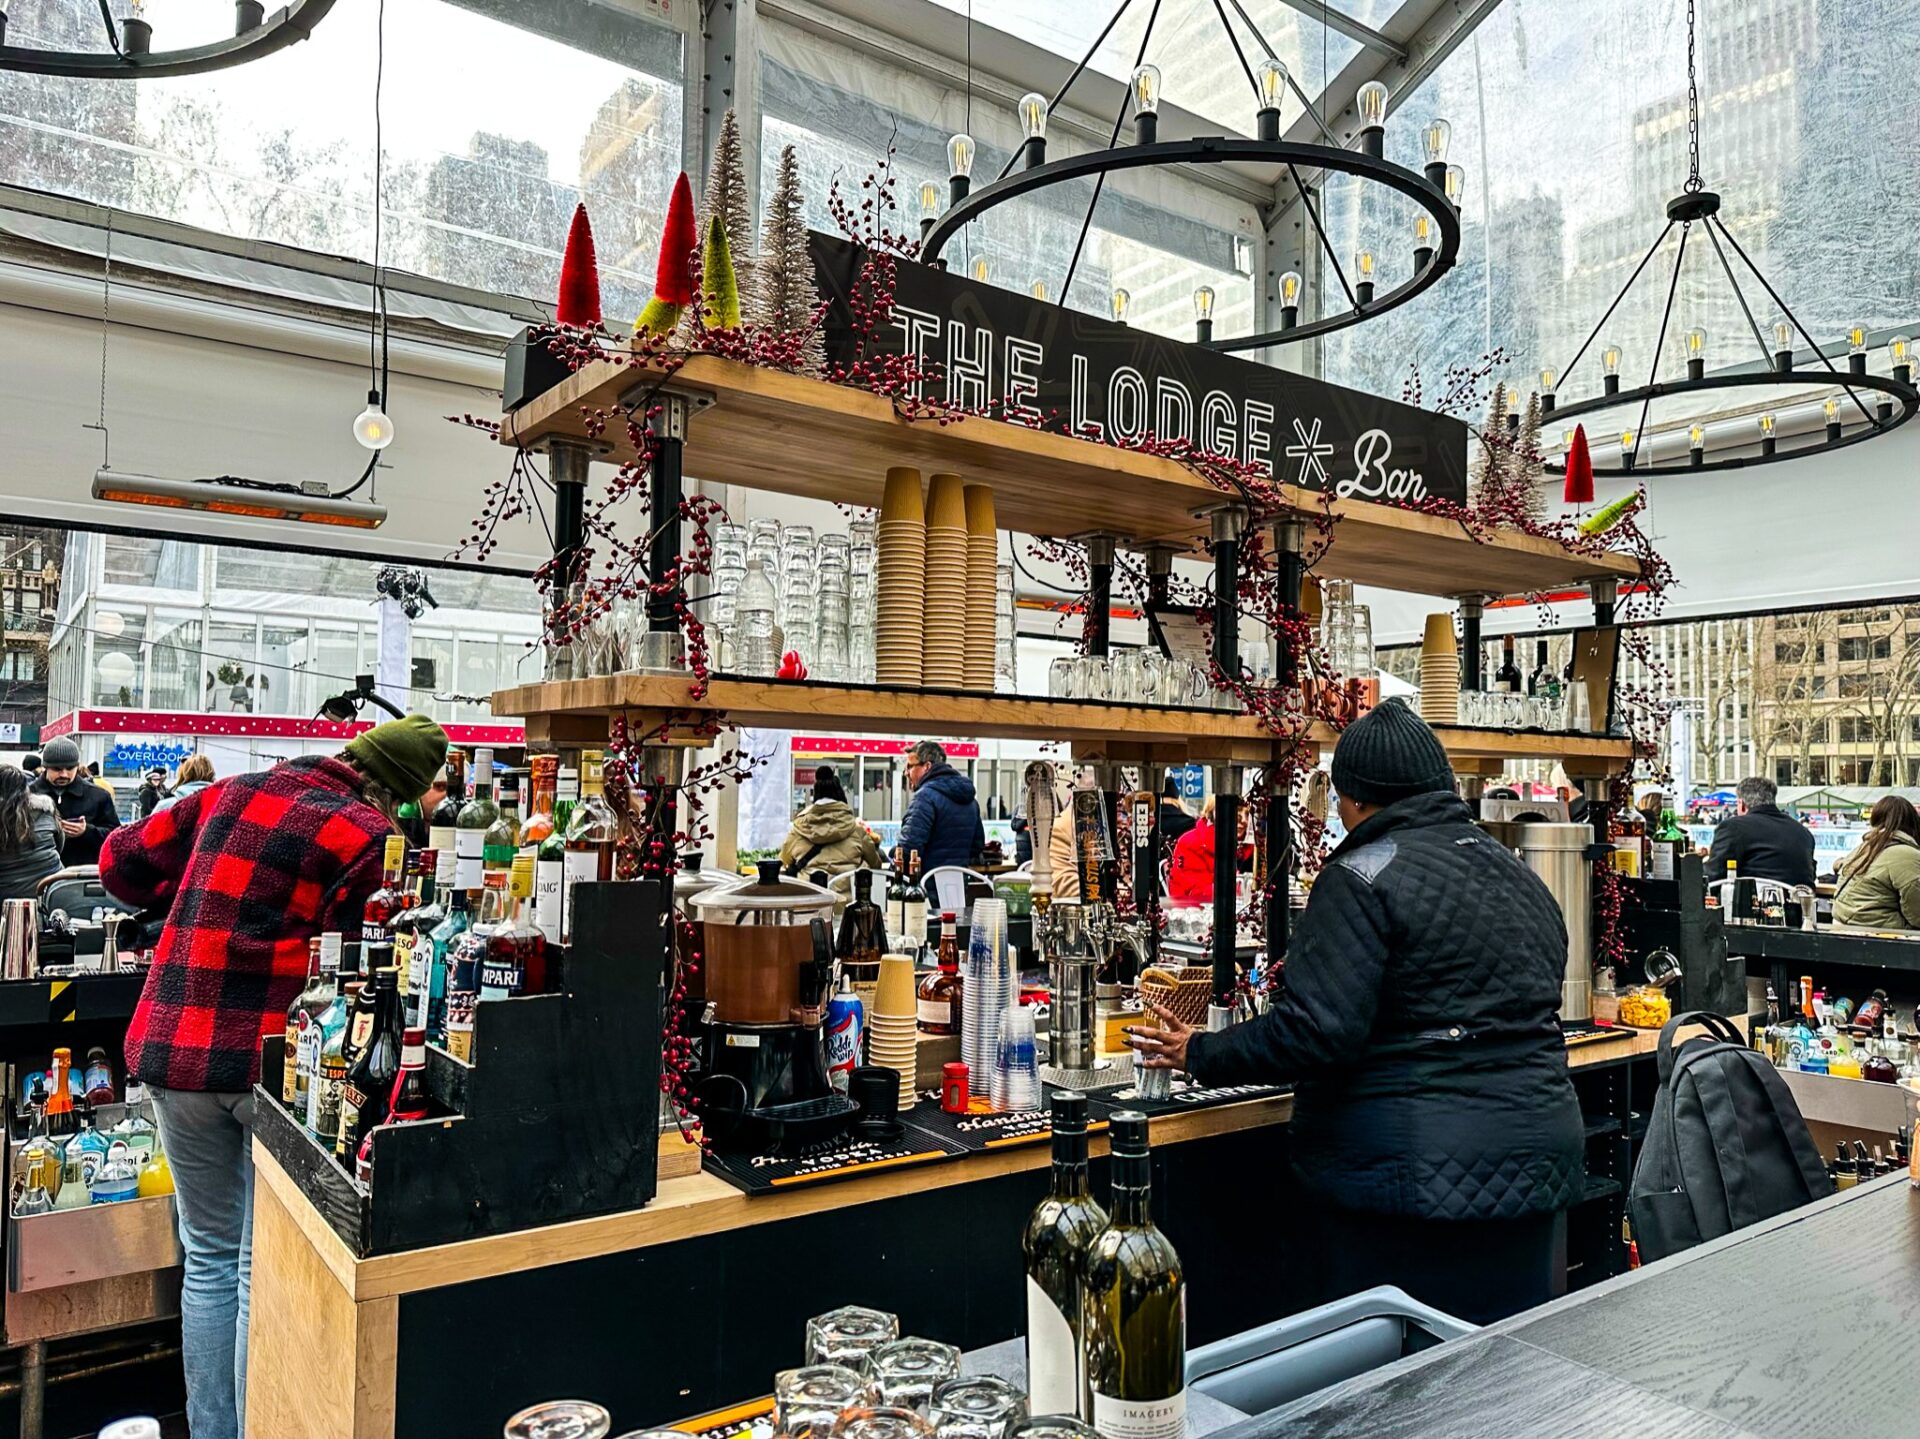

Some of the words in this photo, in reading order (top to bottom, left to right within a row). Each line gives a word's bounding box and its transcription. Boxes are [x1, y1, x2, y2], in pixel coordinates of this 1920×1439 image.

[890, 305, 1043, 432] THE
[1070, 354, 1276, 480] LODGE
[1337, 428, 1428, 502] Bar
[117, 750, 185, 763] OVERLOOK
[362, 926, 385, 940] PARI
[482, 968, 519, 986] MPARI
[957, 1109, 1052, 1132] Handma
[801, 1148, 883, 1166] VODKA
[1123, 1406, 1175, 1419] IMAGERY
